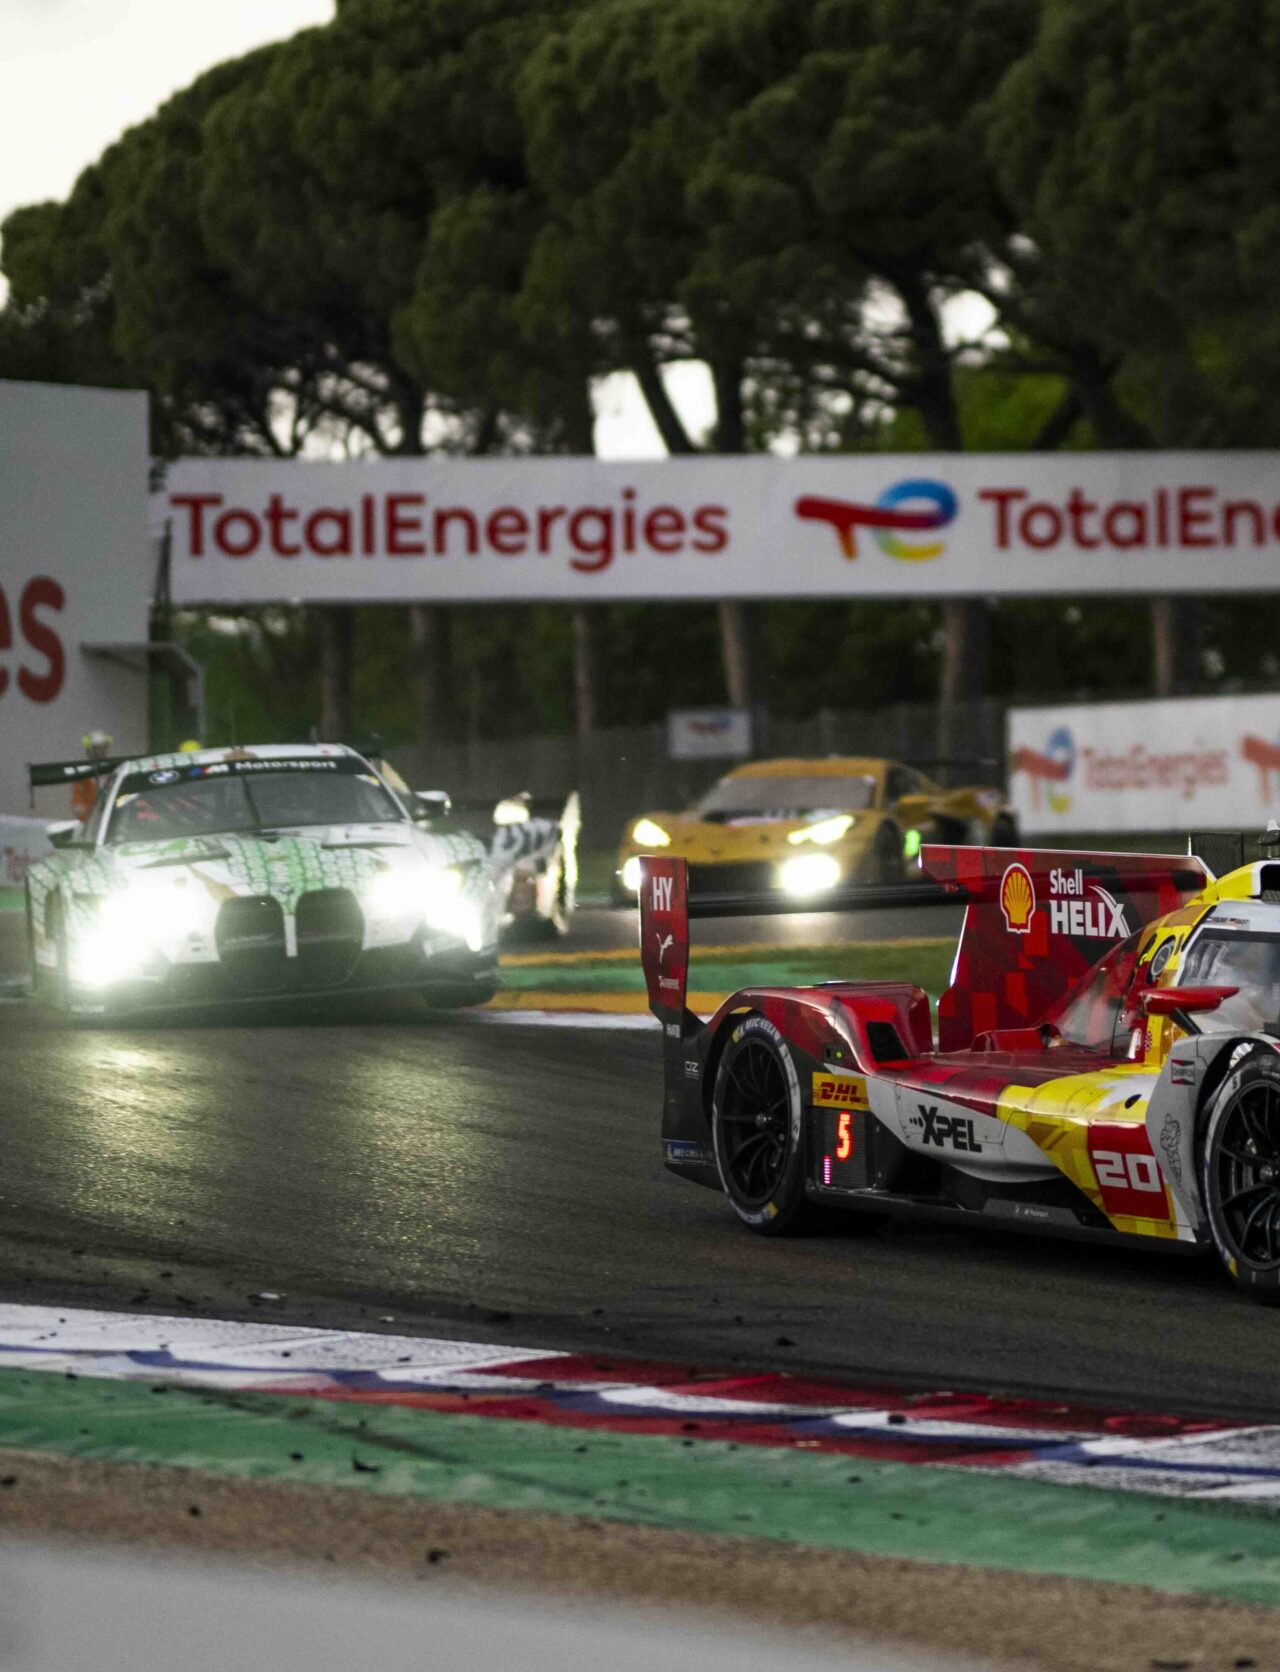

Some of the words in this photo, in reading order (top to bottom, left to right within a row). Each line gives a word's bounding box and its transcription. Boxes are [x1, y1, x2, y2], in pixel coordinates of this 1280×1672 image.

[169, 488, 730, 574] TotalEnergies
[0, 574, 65, 704] s
[235, 760, 337, 770] Motorsport
[653, 877, 673, 911] HY
[1050, 868, 1083, 895] Shell
[1050, 886, 1132, 938] HELIX
[820, 1082, 862, 1103] DHL
[917, 1105, 983, 1153] XPEL
[1092, 1150, 1162, 1193] 20
